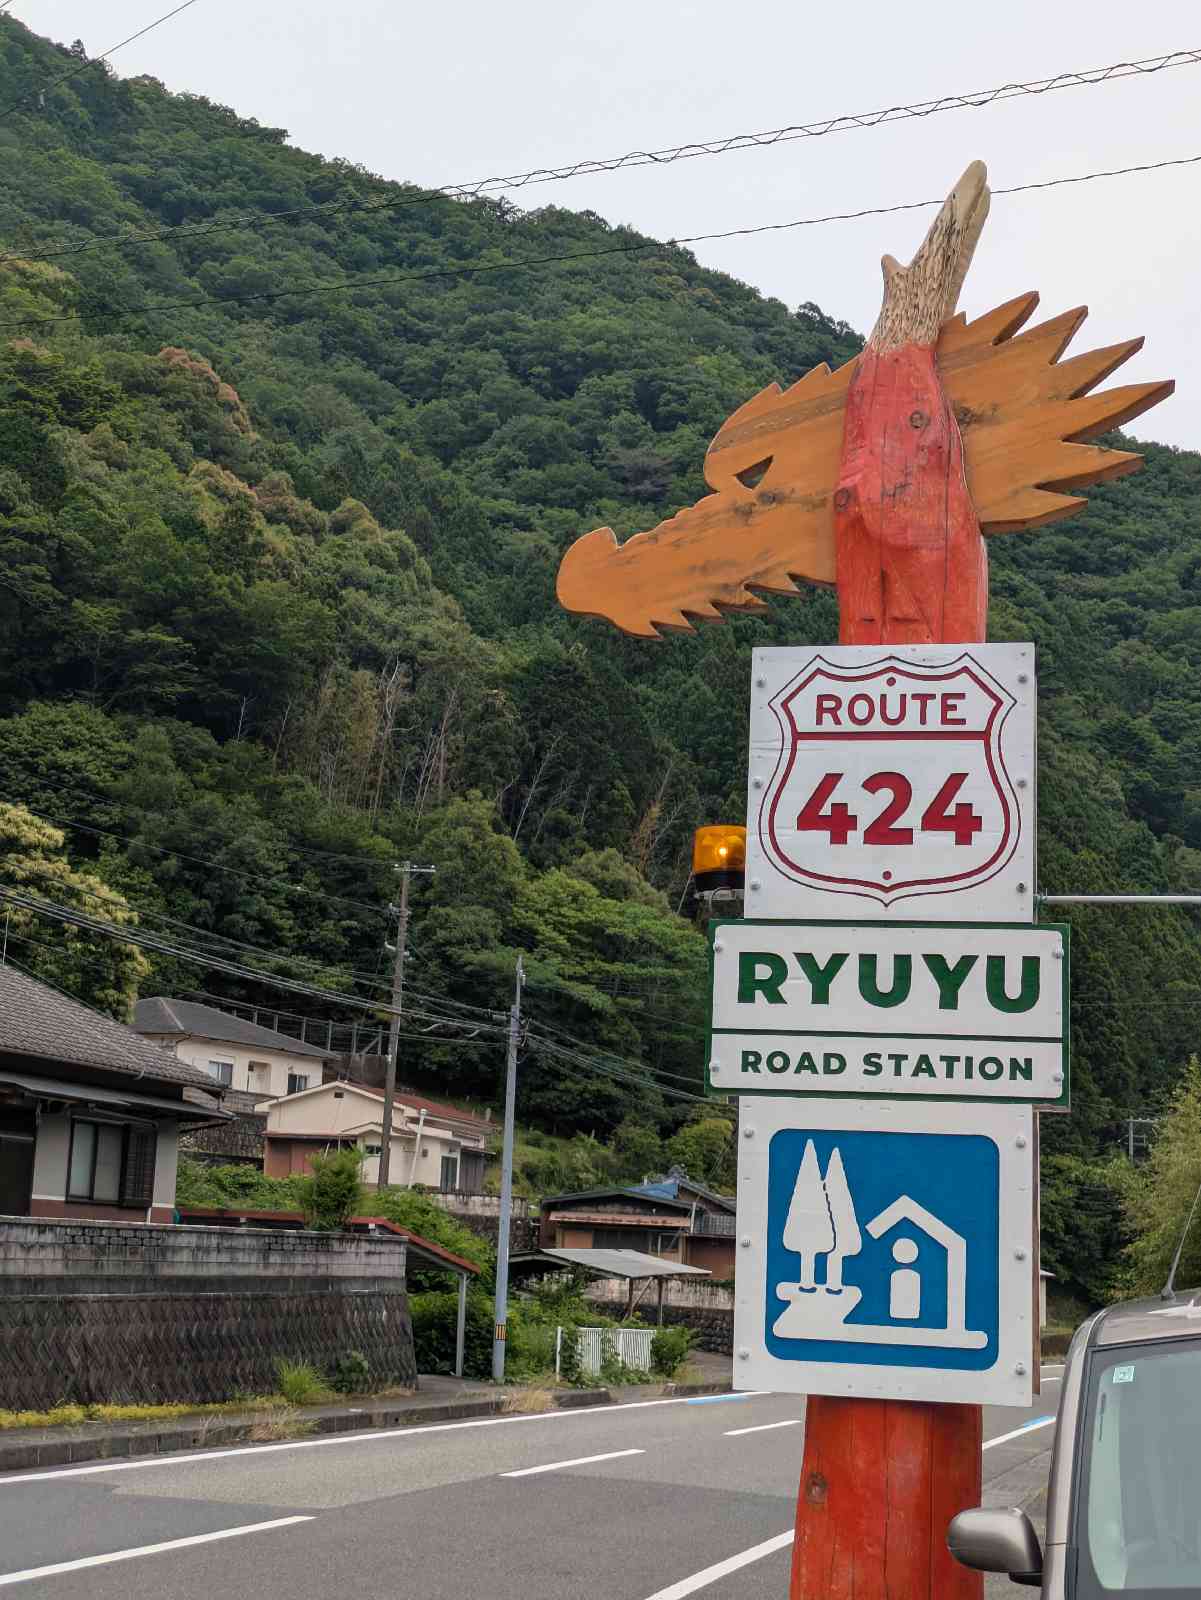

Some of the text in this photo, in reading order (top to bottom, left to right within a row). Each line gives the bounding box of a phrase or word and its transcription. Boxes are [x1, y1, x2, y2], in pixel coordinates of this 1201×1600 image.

[815, 693, 967, 726] ROUTE
[796, 771, 983, 846] 424
[737, 951, 1041, 1014] RYUYU
[741, 1050, 1033, 1081] ROAD STATION
